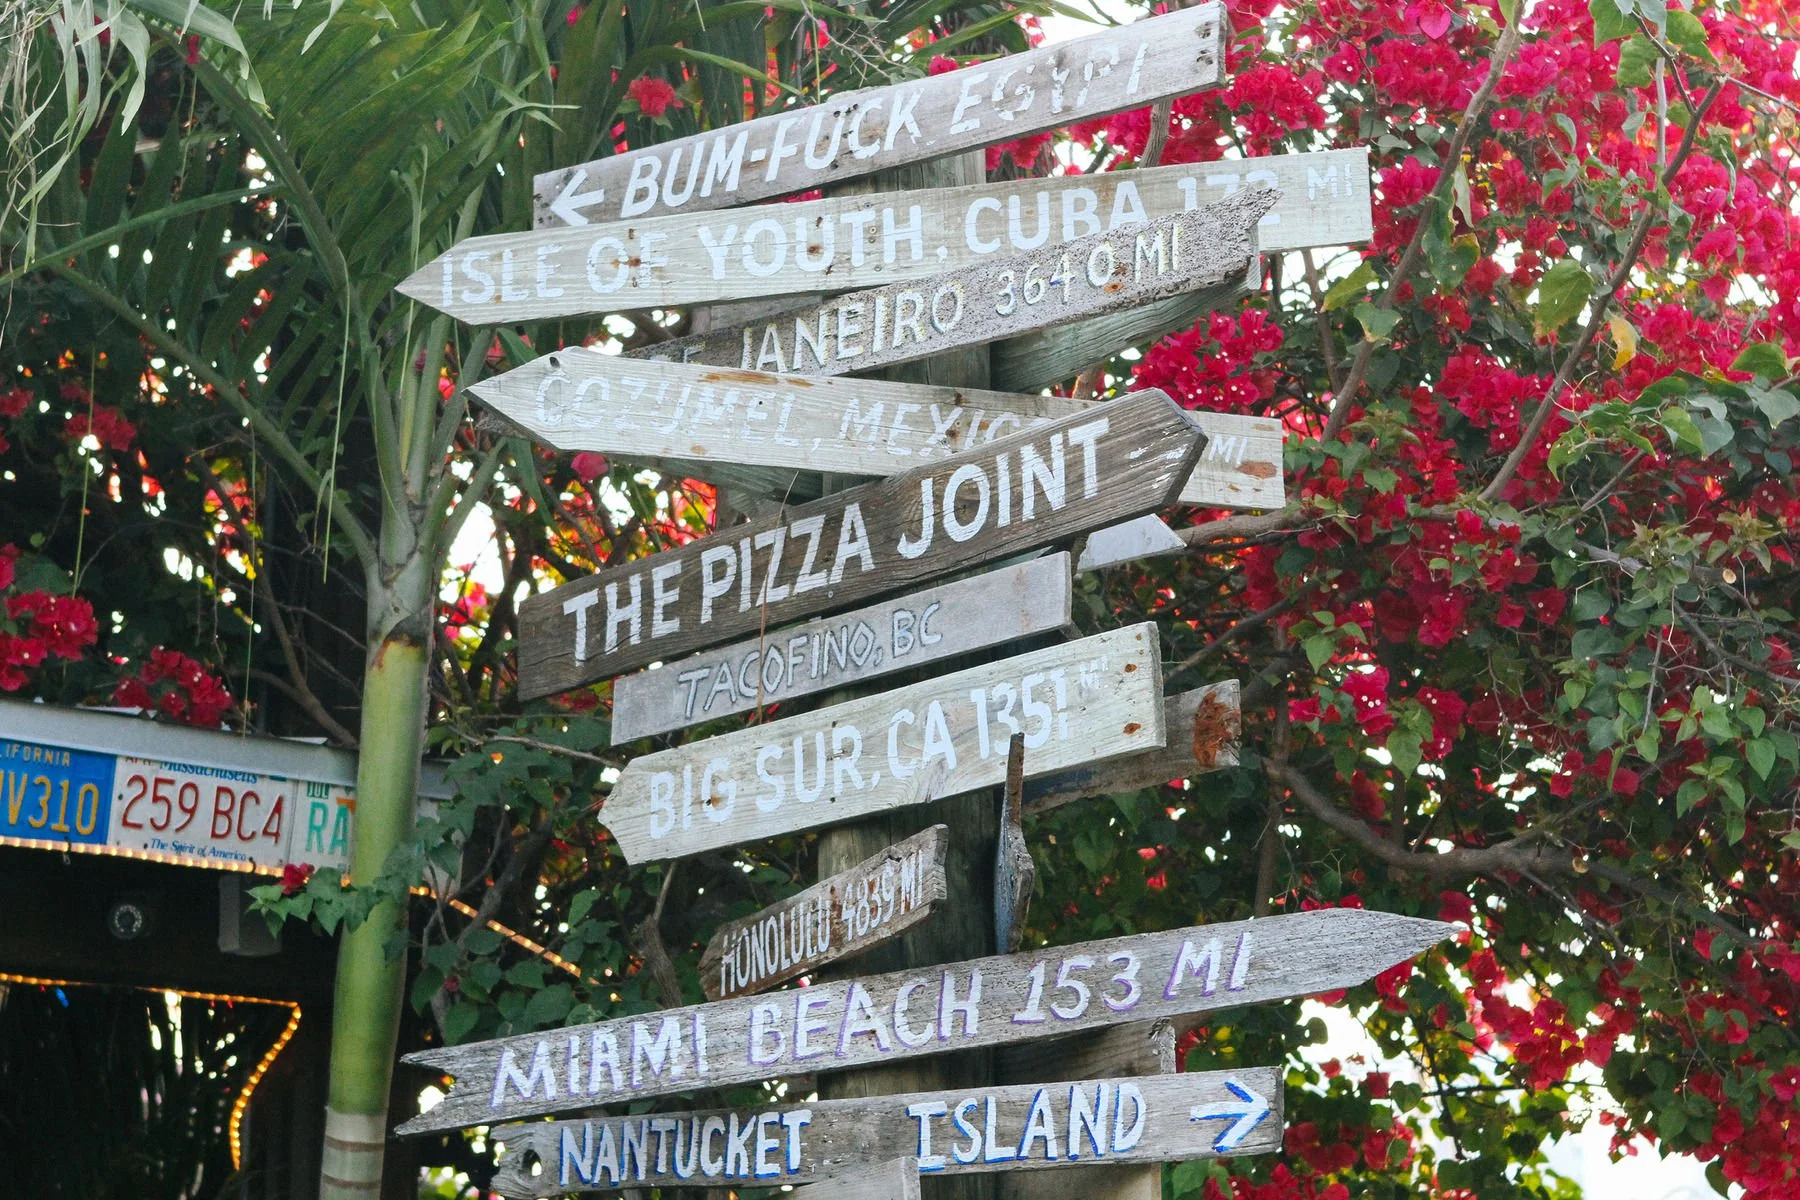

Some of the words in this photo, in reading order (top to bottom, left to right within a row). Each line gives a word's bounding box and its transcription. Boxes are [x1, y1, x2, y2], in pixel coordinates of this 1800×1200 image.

[620, 87, 925, 218] BUM-FUCK
[442, 245, 564, 308] ISLE
[587, 232, 668, 294] OF
[697, 204, 948, 281] YOUTH,
[964, 181, 1150, 254] CUBA
[1307, 163, 1353, 201] MI
[995, 243, 1116, 317] 3640
[1134, 222, 1183, 284] MI
[838, 397, 1054, 457] MEXIC
[1208, 435, 1248, 465] MI
[563, 559, 683, 668] THE
[700, 502, 876, 625] PIZZA
[896, 417, 1110, 560] JOINT
[678, 620, 884, 720] TACOFINO,
[891, 600, 943, 660] BC
[0, 743, 71, 767] IFORNIA
[121, 774, 200, 832] 259
[210, 785, 285, 845] BC4
[650, 757, 737, 839] BIG
[755, 725, 881, 813] SUR,
[887, 699, 957, 781] CA
[970, 668, 1070, 761] 1351
[150, 838, 169, 851] The
[171, 839, 196, 857] Spirit
[719, 895, 832, 997] HONOLULU
[900, 849, 923, 916] MI
[490, 1012, 710, 1111] MIAMI
[748, 966, 983, 1067] BEACH
[1011, 948, 1143, 1026] 153
[1162, 931, 1252, 1001] MI
[560, 1109, 813, 1188] NANTUCKET
[905, 1083, 1148, 1174] ISLAND
